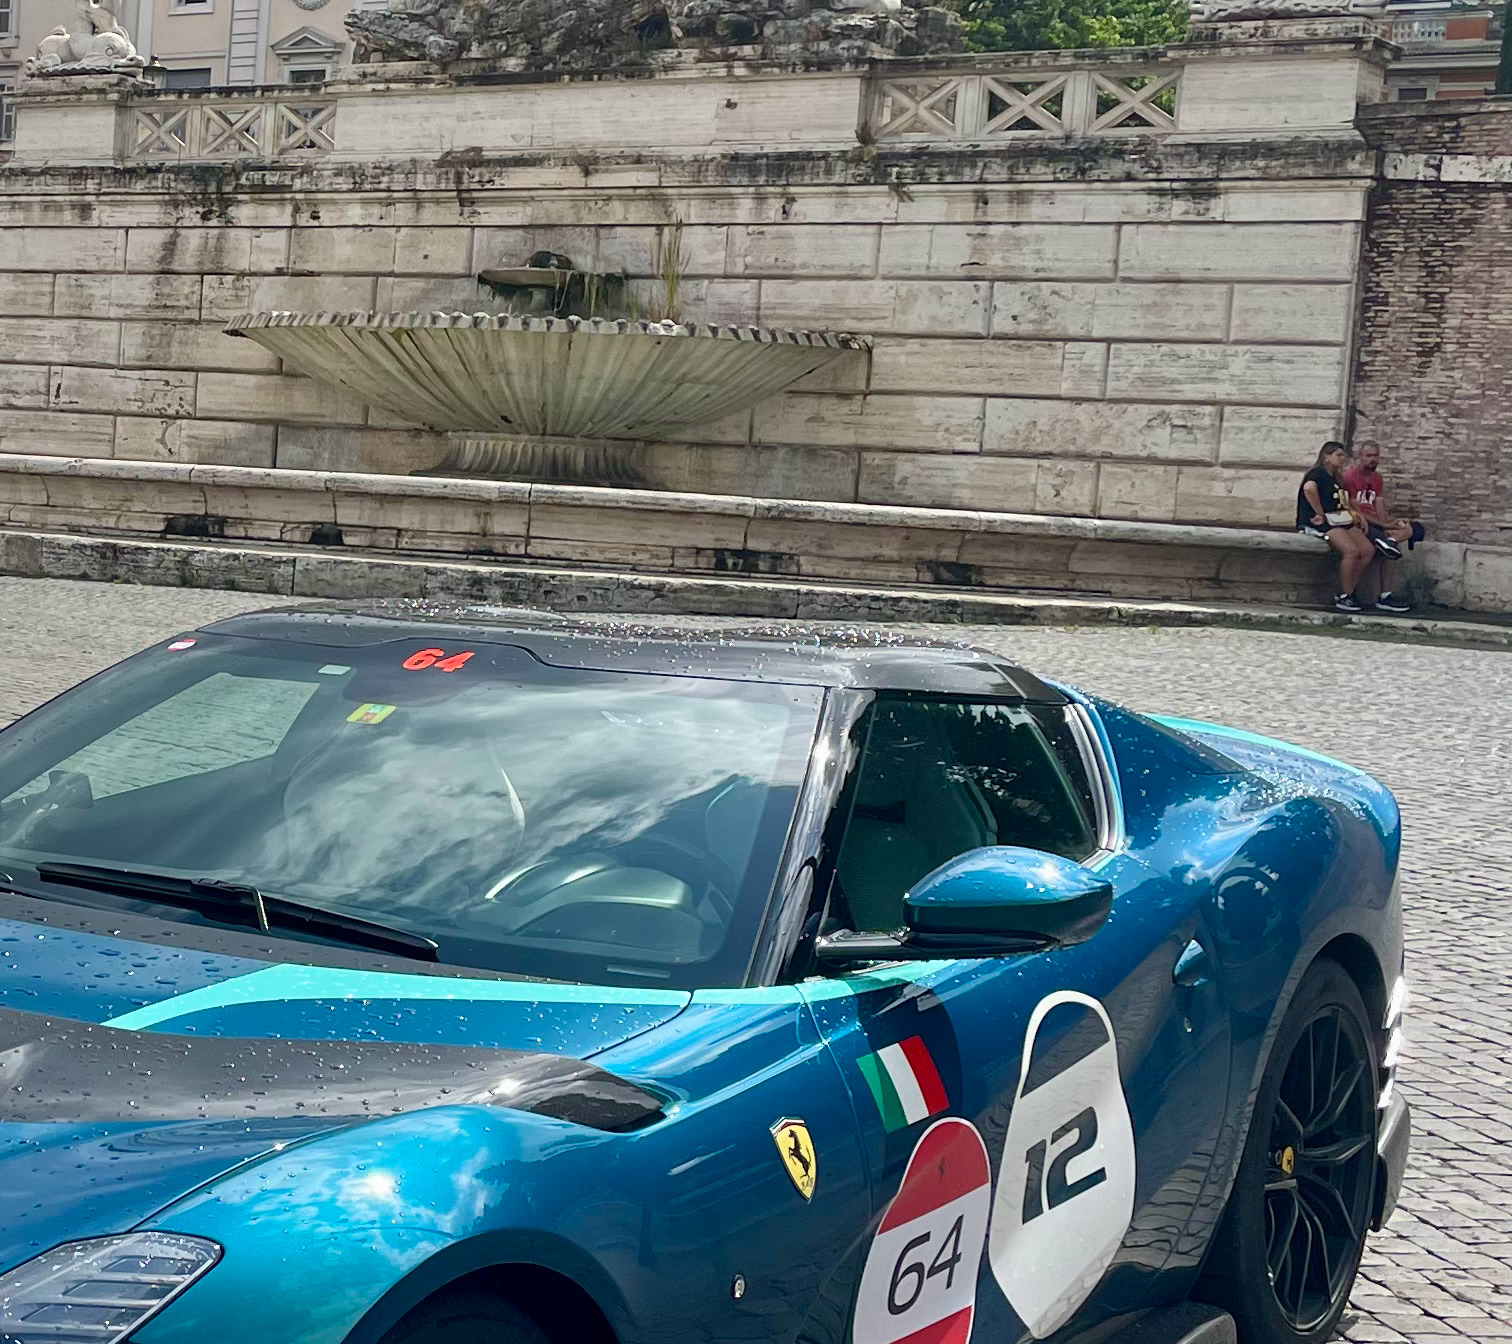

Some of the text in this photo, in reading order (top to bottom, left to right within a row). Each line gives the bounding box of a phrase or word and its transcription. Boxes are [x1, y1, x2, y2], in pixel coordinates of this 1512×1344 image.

[403, 648, 475, 672] 64
[1022, 1106, 1108, 1225] 12
[888, 1214, 964, 1316] 64
